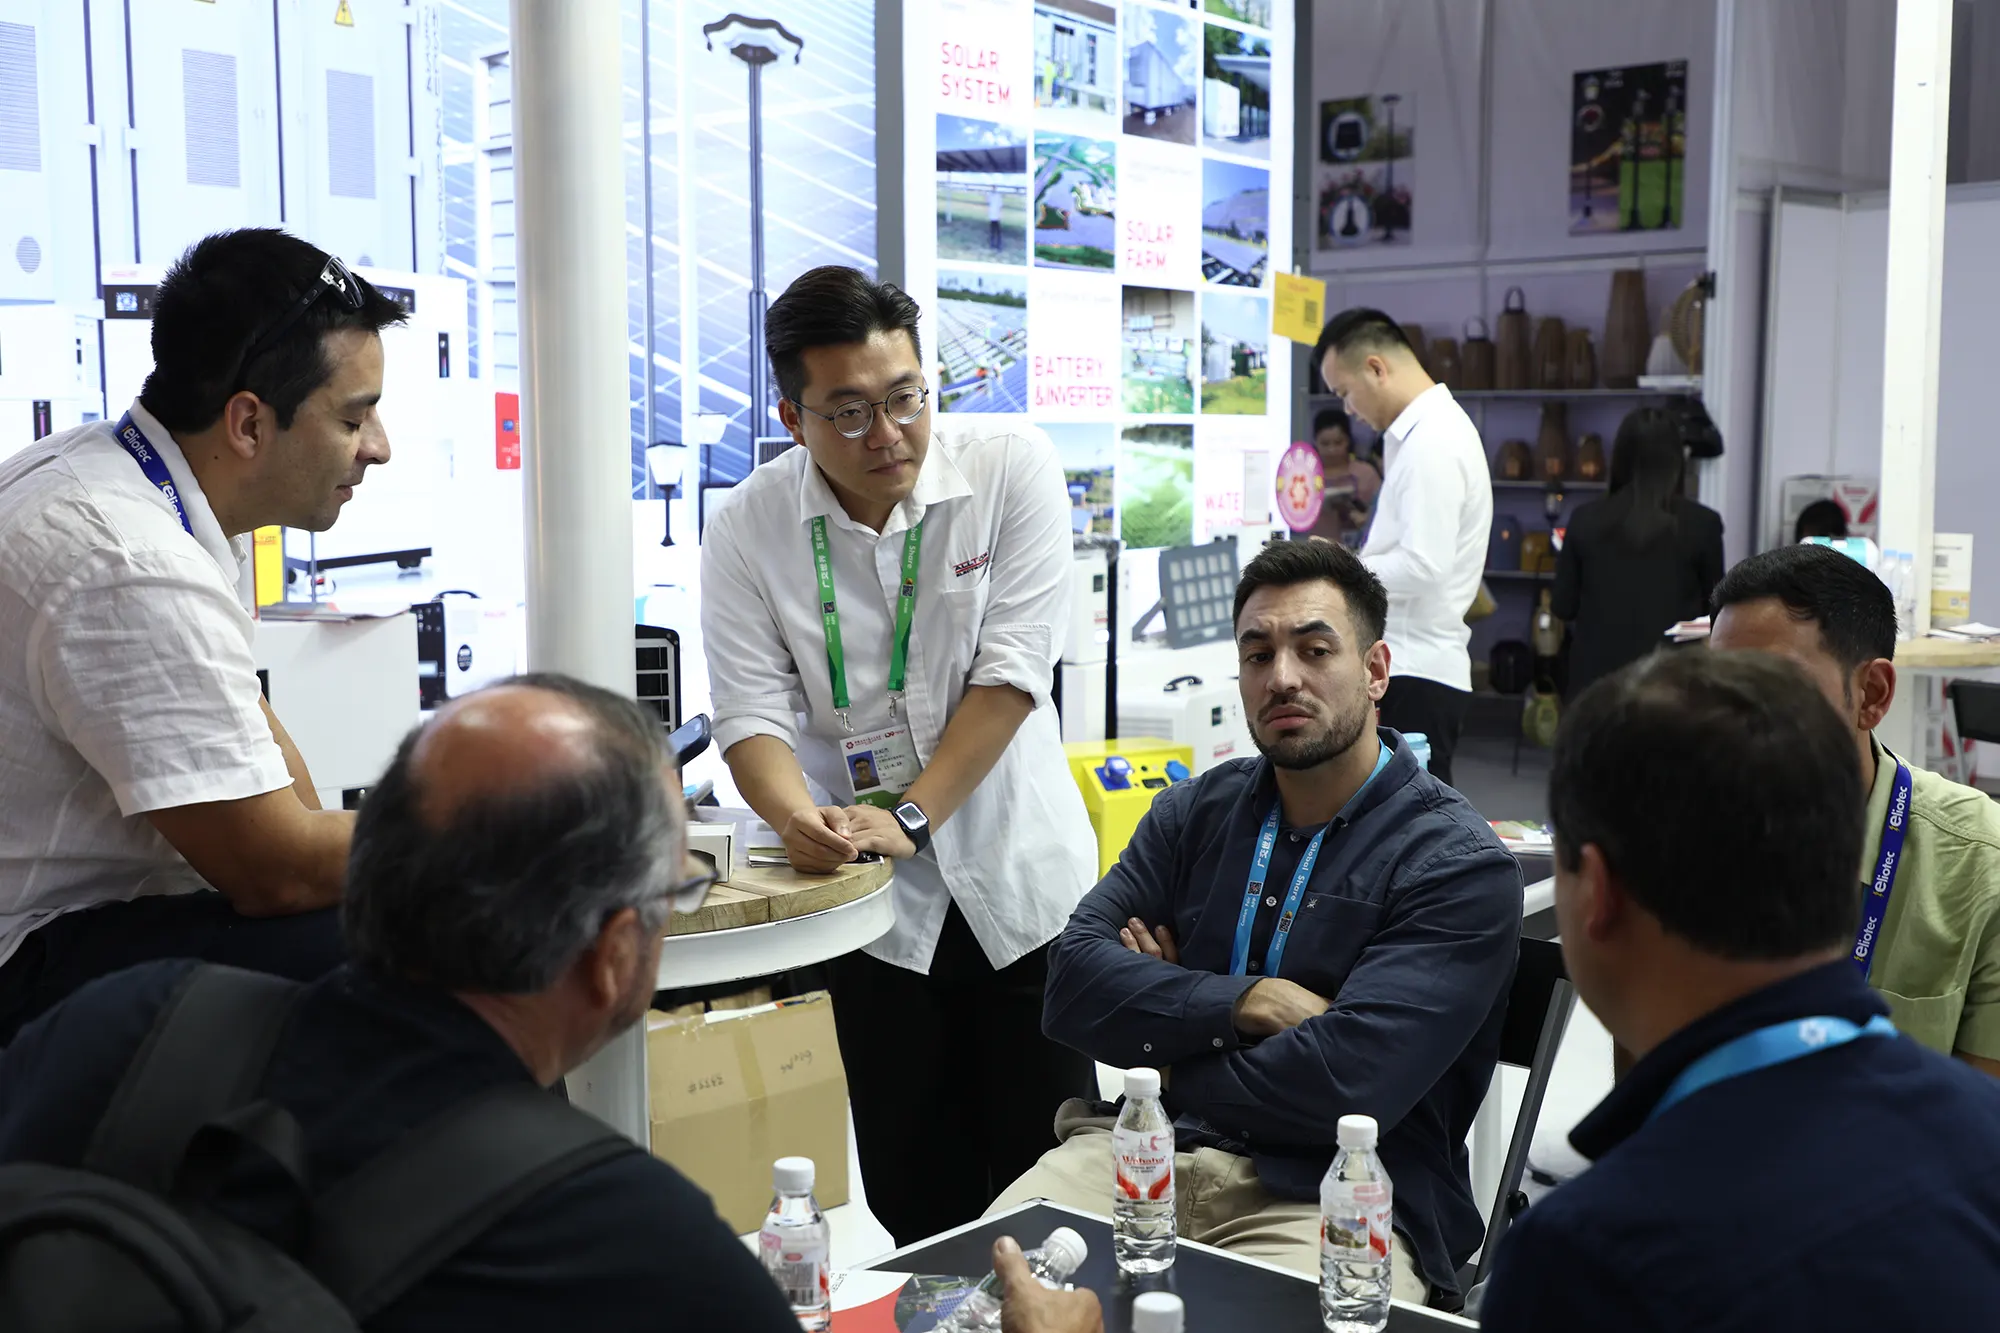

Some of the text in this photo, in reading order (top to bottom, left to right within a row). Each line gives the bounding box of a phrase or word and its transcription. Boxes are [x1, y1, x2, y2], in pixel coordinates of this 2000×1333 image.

[942, 41, 999, 74] SOLAR
[942, 73, 1011, 106] SYSTEM
[1127, 220, 1175, 245] SOLAR
[1127, 248, 1167, 270] FARM
[1035, 355, 1104, 378] BATTERY
[1035, 384, 1113, 407] &INVERTER
[1204, 491, 1241, 511] WATE
[907, 528, 918, 569] bal Share
[818, 555, 830, 588] 广交世界
[1257, 832, 1273, 868] 广交世界
[1290, 841, 1318, 901] Global Share
